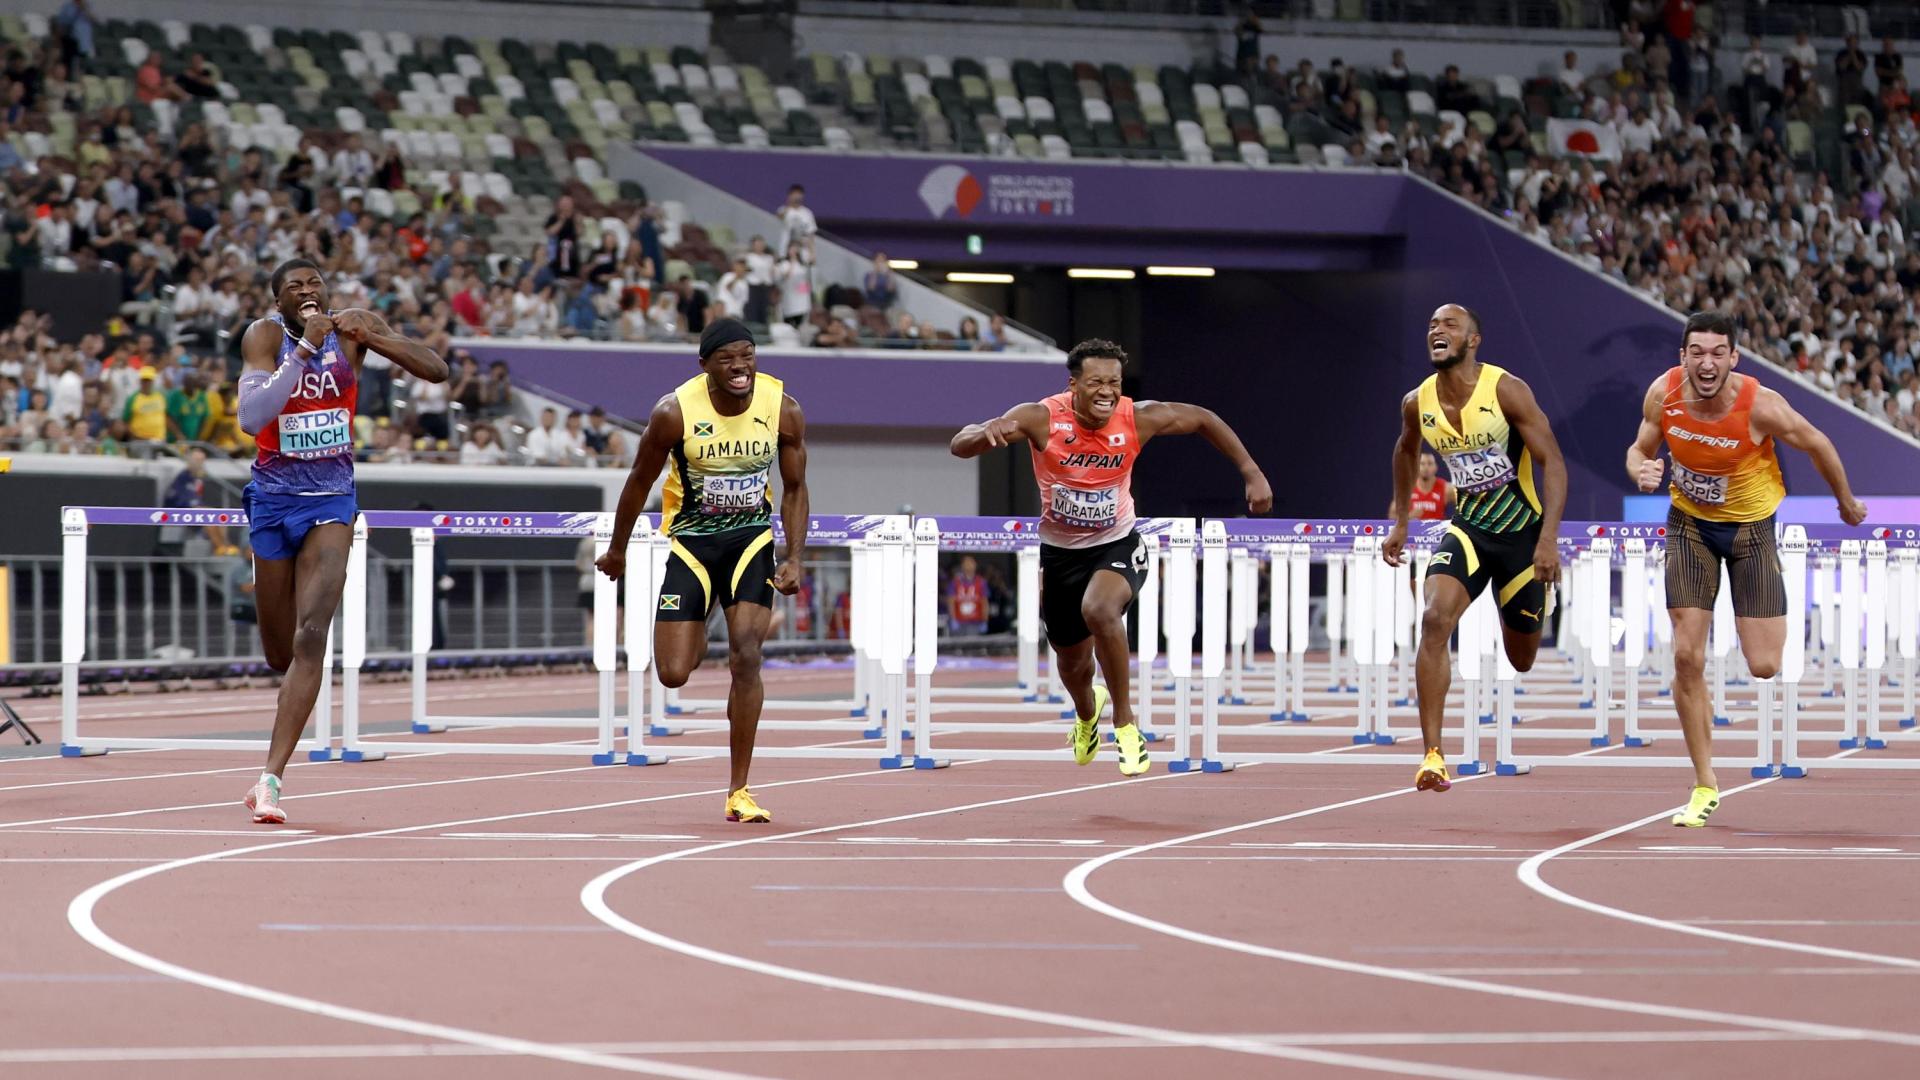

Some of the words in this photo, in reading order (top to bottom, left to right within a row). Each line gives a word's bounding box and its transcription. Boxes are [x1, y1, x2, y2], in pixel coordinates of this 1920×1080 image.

[298, 410, 344, 428] TDK
[287, 427, 344, 448] TINCH
[1435, 432, 1497, 451] JAMAICA
[1667, 425, 1740, 449] ESPAÑA
[696, 440, 771, 460] JAMAICA
[1456, 447, 1499, 467] TDK
[1060, 453, 1124, 468] JAPAN
[725, 472, 764, 491] TDK
[1454, 458, 1507, 486] MASON
[1681, 468, 1722, 487] TDK
[707, 490, 761, 506] BENNET
[1070, 488, 1114, 503] TDK
[1683, 480, 1720, 500] OPIS
[1055, 498, 1115, 519] MURATAKE
[1609, 527, 1666, 537] TOKYO
